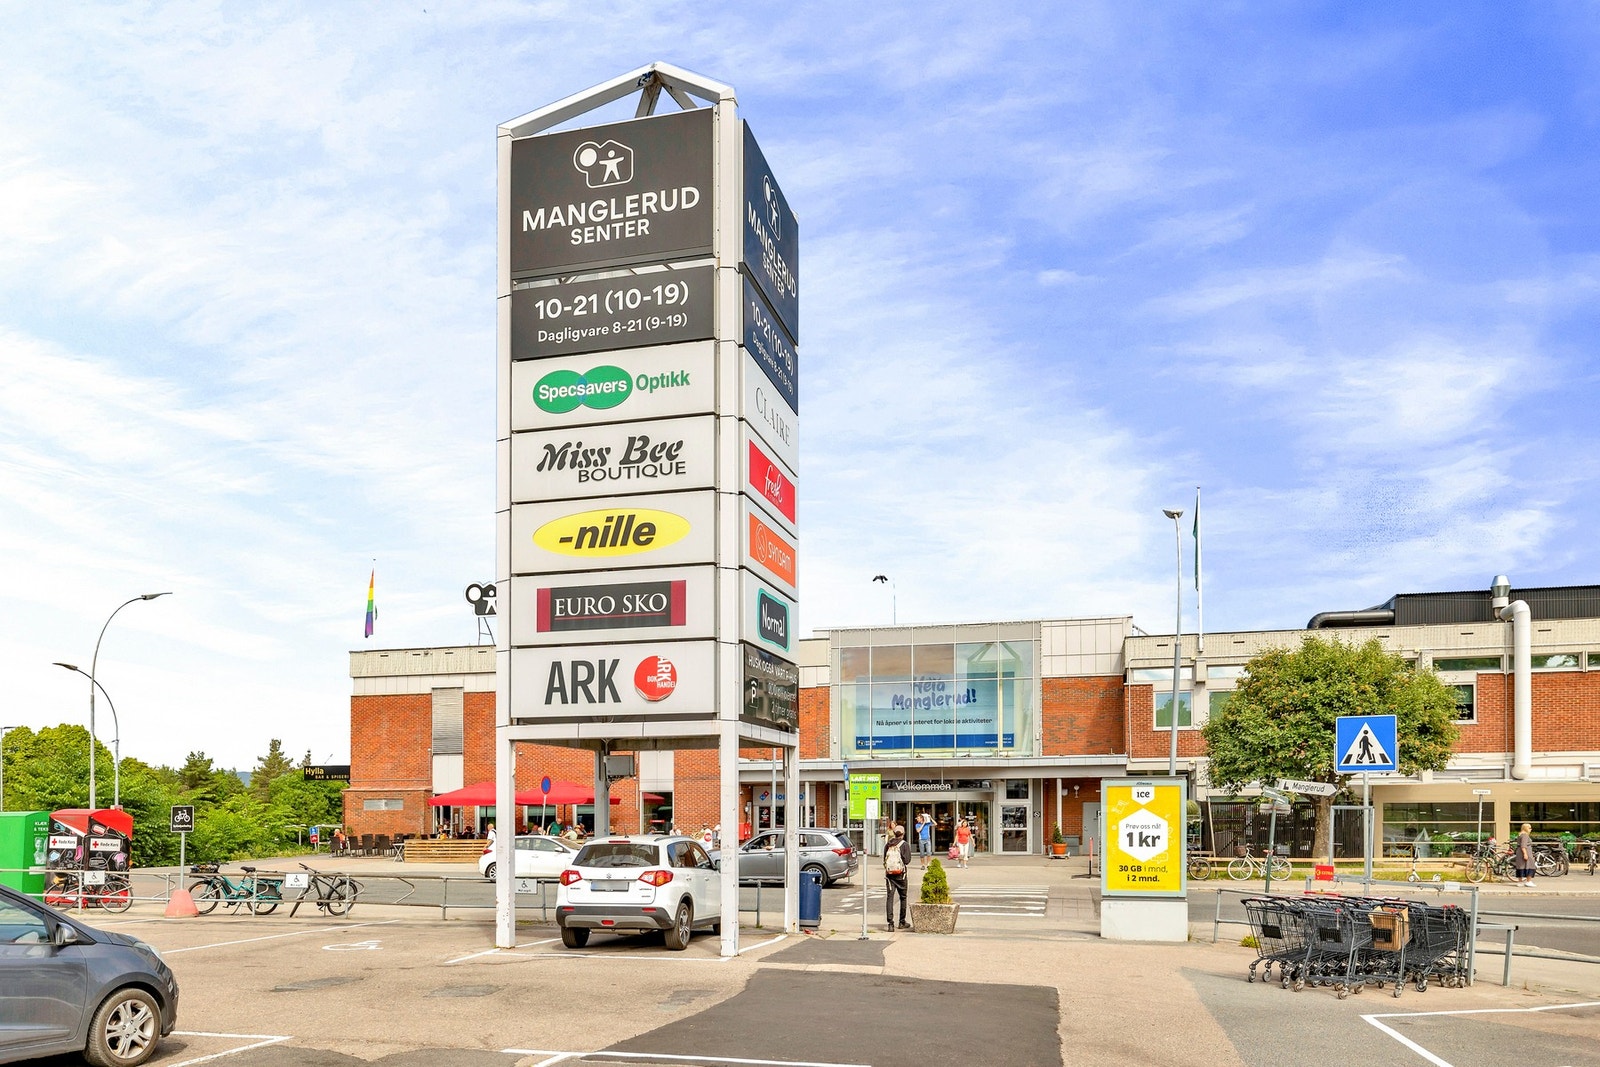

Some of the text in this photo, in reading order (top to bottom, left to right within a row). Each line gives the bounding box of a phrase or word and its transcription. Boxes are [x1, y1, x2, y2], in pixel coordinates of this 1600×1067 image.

[522, 186, 700, 232] MANGLERUD
[570, 219, 650, 246] SENTER
[748, 201, 797, 298] MANGLERUD
[762, 252, 785, 299] SENTER
[534, 281, 689, 320] 10-21 (10-19)
[538, 312, 688, 344] Dagligvare 8-21 (9-19)
[752, 301, 771, 343] 10-21
[538, 370, 690, 402] Specsavers Optikk
[755, 387, 790, 447] CLAIRE
[536, 435, 684, 472] Miss Bee
[578, 461, 686, 483] BOUTIQUE
[559, 514, 656, 550] -nille
[554, 593, 668, 616] EURO SKO
[762, 602, 785, 637] Normal
[544, 659, 622, 705] ARK
[892, 688, 977, 710] Manglerud!
[305, 767, 324, 775] Hylla
[895, 782, 951, 791] Velkommen
[1292, 782, 1325, 793] Manglerud
[1126, 831, 1161, 847] 1 kr
